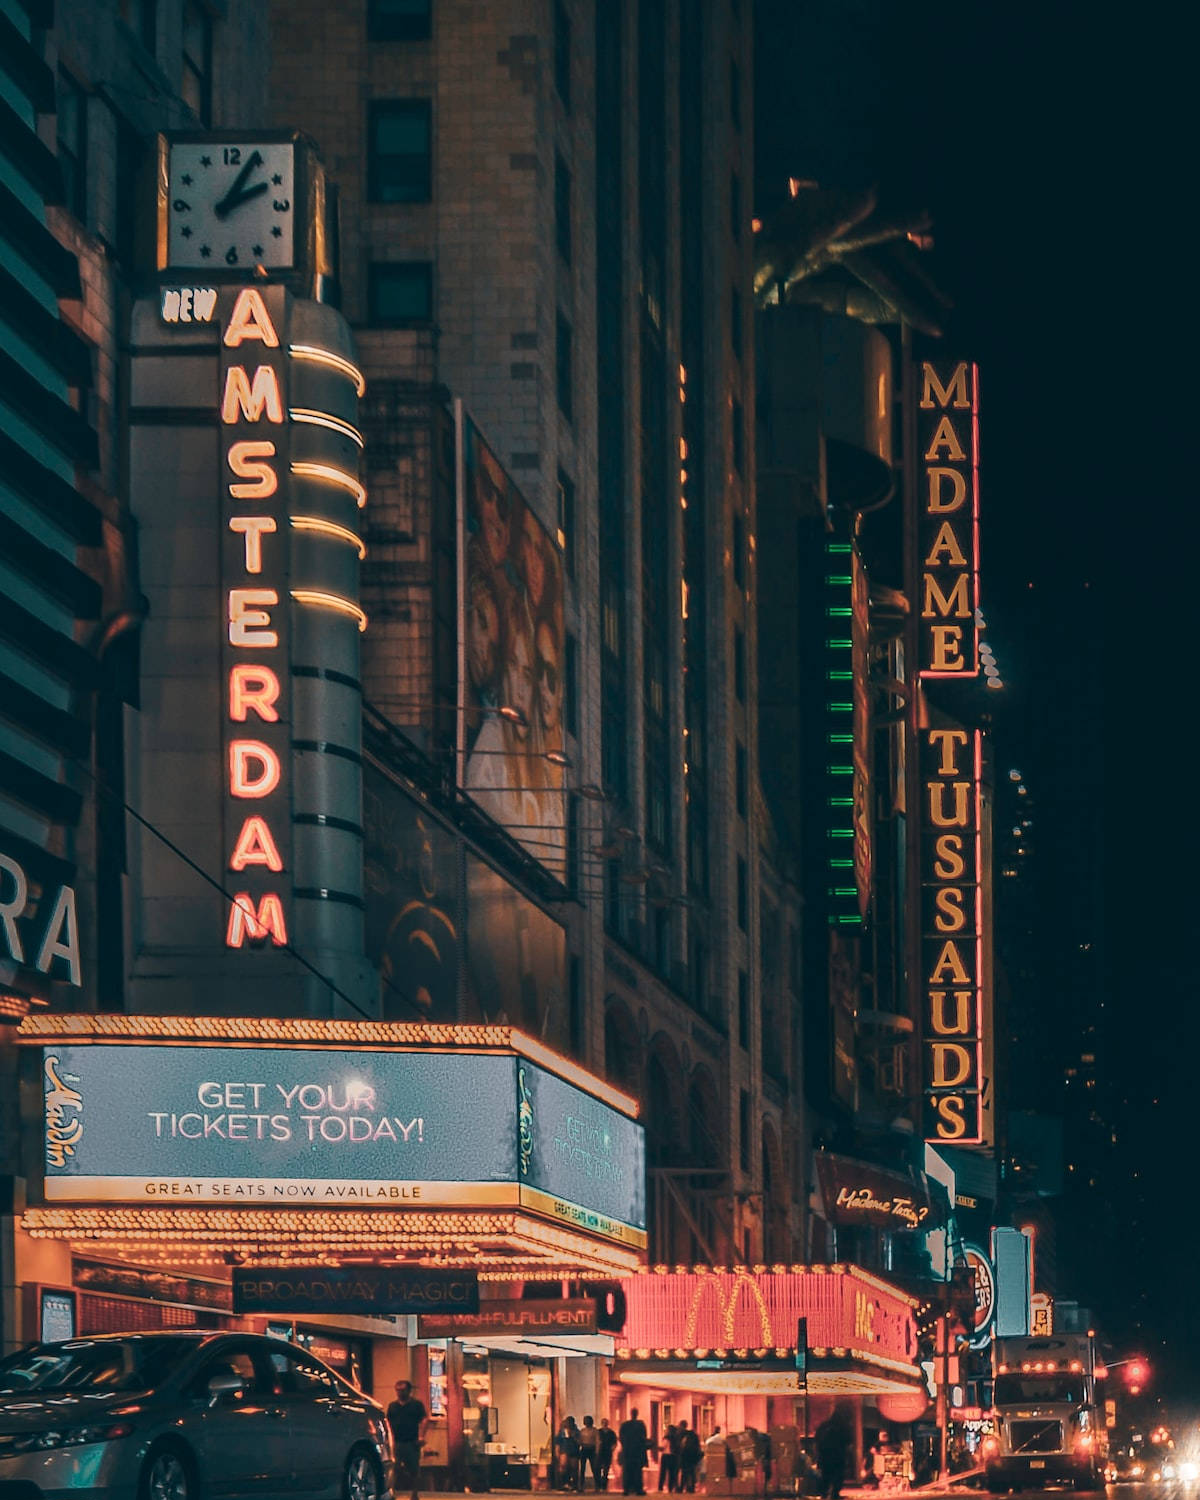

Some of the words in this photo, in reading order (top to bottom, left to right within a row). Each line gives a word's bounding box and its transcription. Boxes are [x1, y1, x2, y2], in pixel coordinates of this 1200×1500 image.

[223, 148, 241, 166] 12
[162, 288, 217, 323] NEW
[920, 362, 972, 672] MADAME
[221, 288, 288, 949] AMSTERDAM
[928, 729, 971, 1139] TUSSAUD'S
[198, 1082, 266, 1109] GET
[276, 1083, 376, 1111] YOUR
[148, 1112, 291, 1141] TICKETS
[300, 1115, 424, 1142] TODAY!
[145, 1183, 203, 1195] GREAT
[212, 1184, 265, 1196] SEATS
[273, 1185, 316, 1197] NOW
[324, 1186, 421, 1198] AVAILABLE
